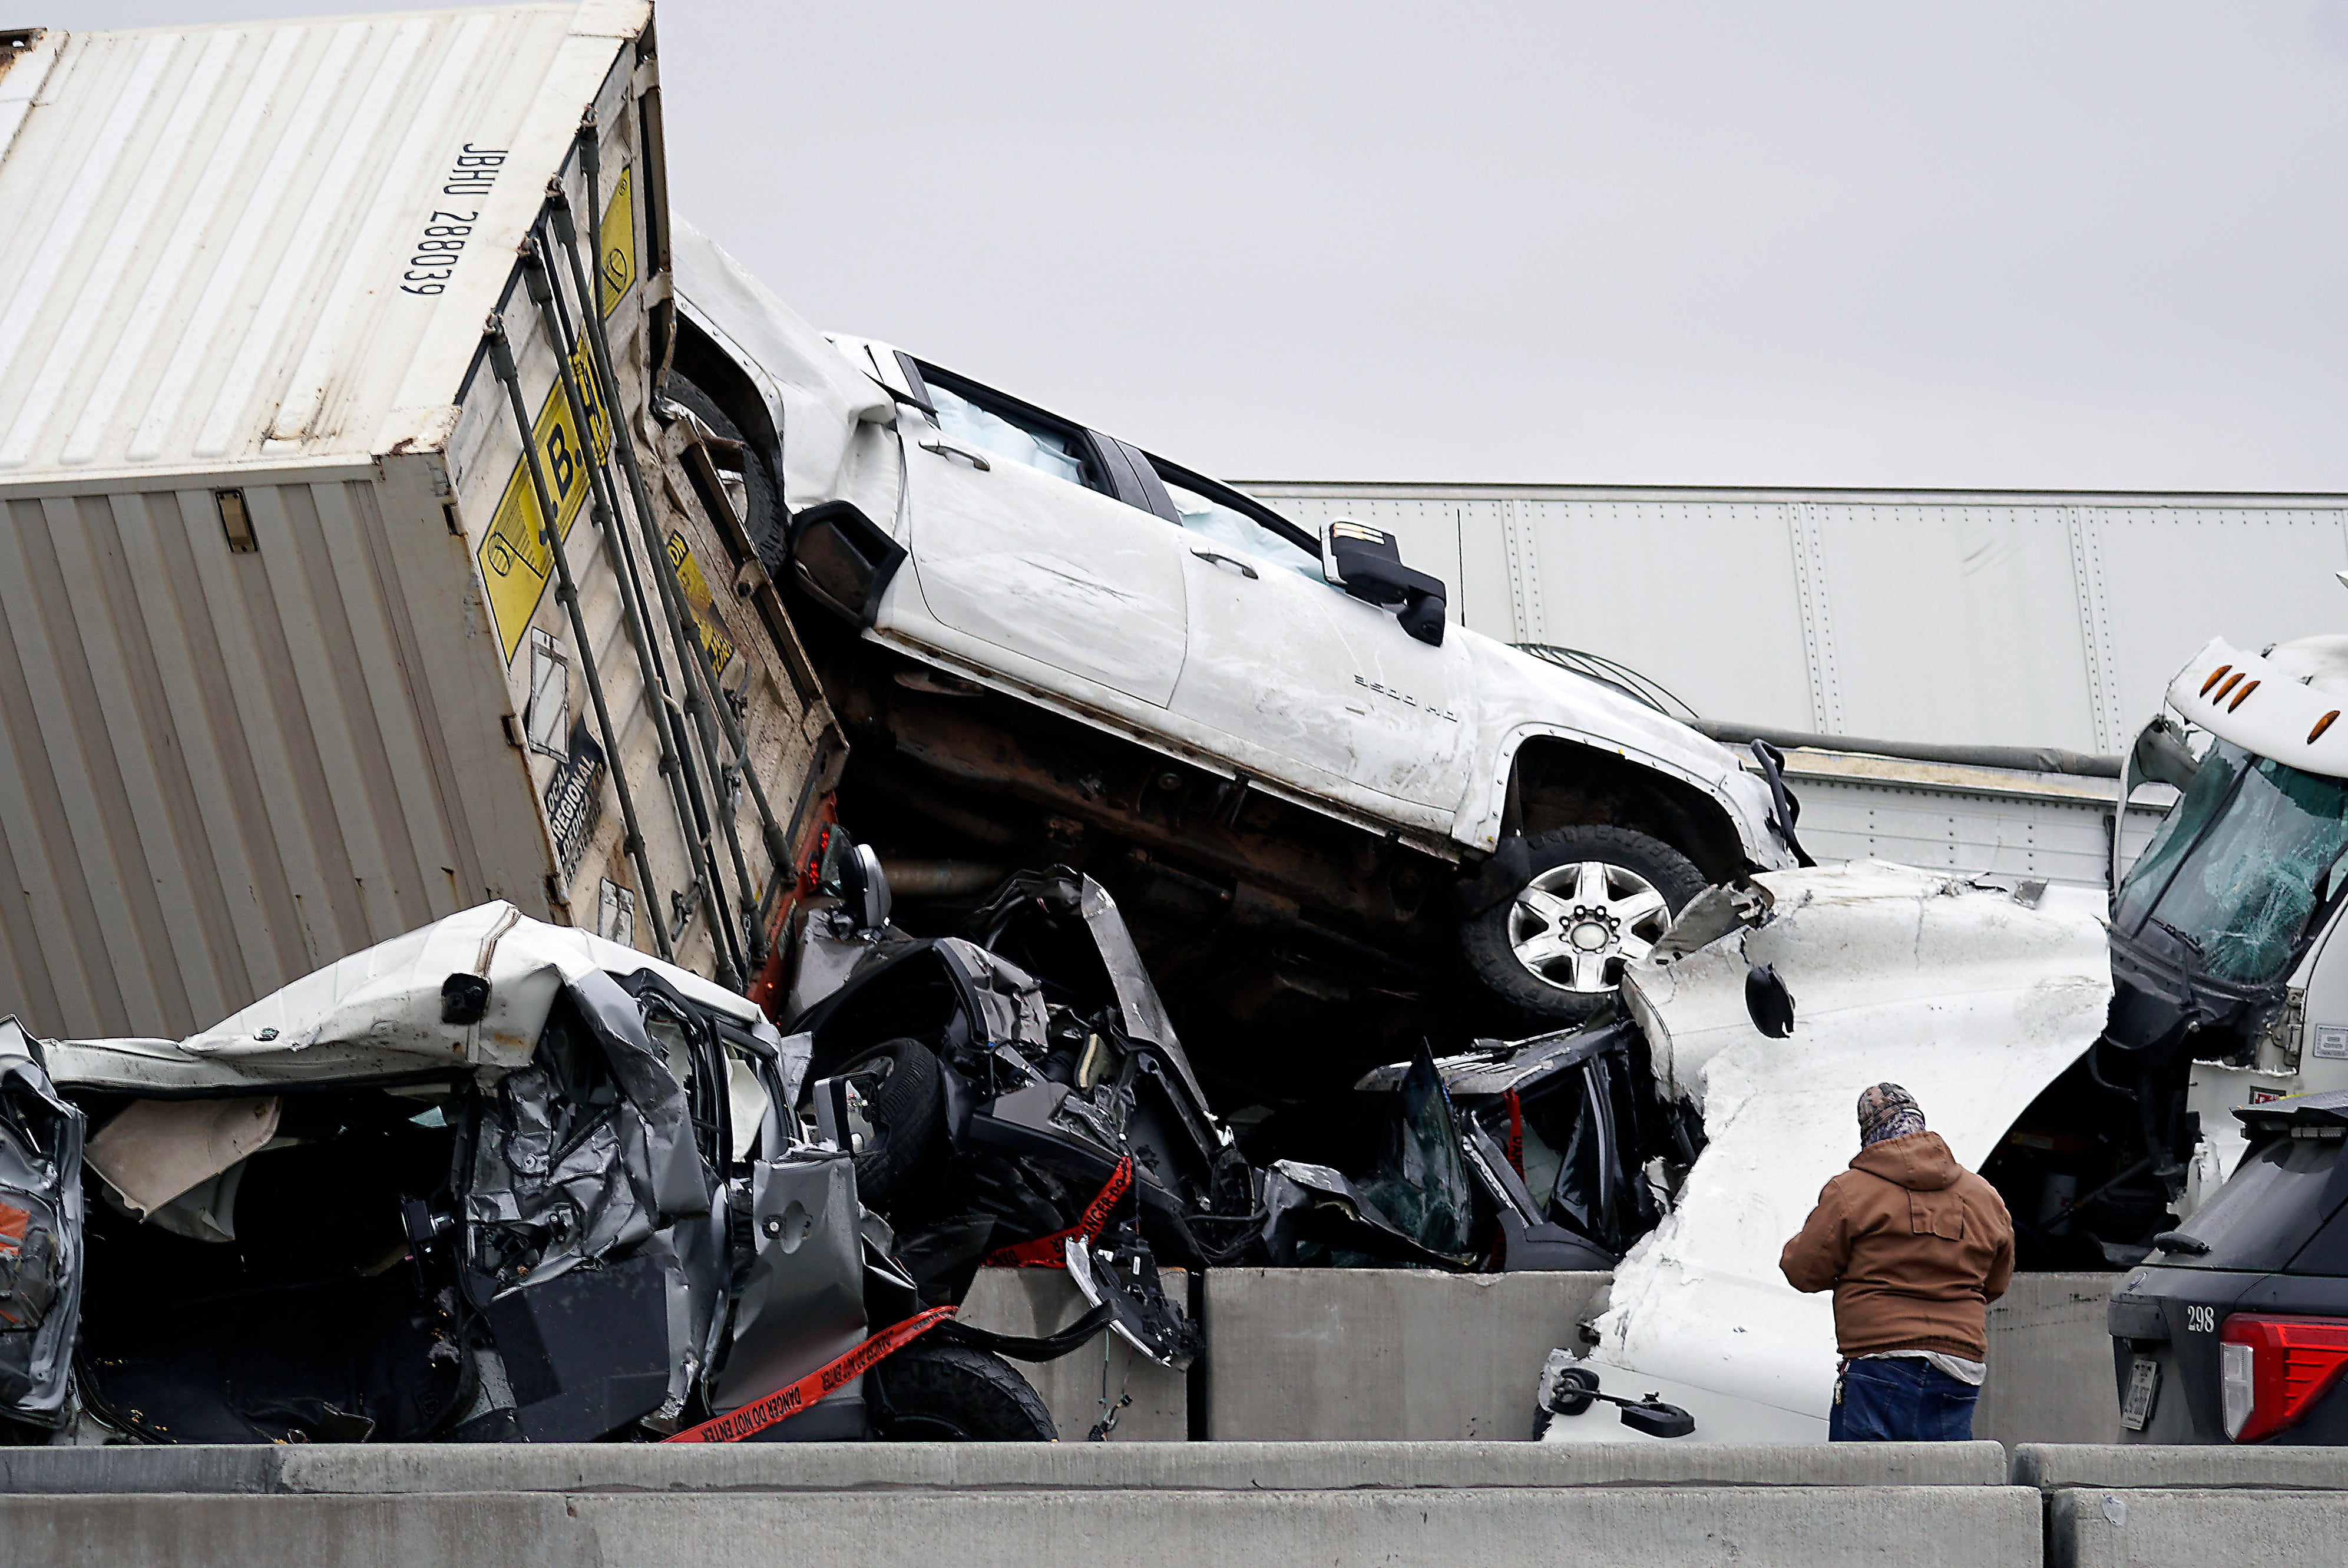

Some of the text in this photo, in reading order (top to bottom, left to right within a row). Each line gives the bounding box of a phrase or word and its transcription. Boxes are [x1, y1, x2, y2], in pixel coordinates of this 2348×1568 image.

[399, 143, 508, 295] JBHU 288039
[551, 755, 596, 841] REGIONAL
[1083, 1198, 1114, 1239] ANGER
[2187, 1305, 2215, 1333] 298
[752, 1404, 768, 1426] DO
[766, 1386, 802, 1418] DANGER
[733, 1410, 754, 1436] NOT
